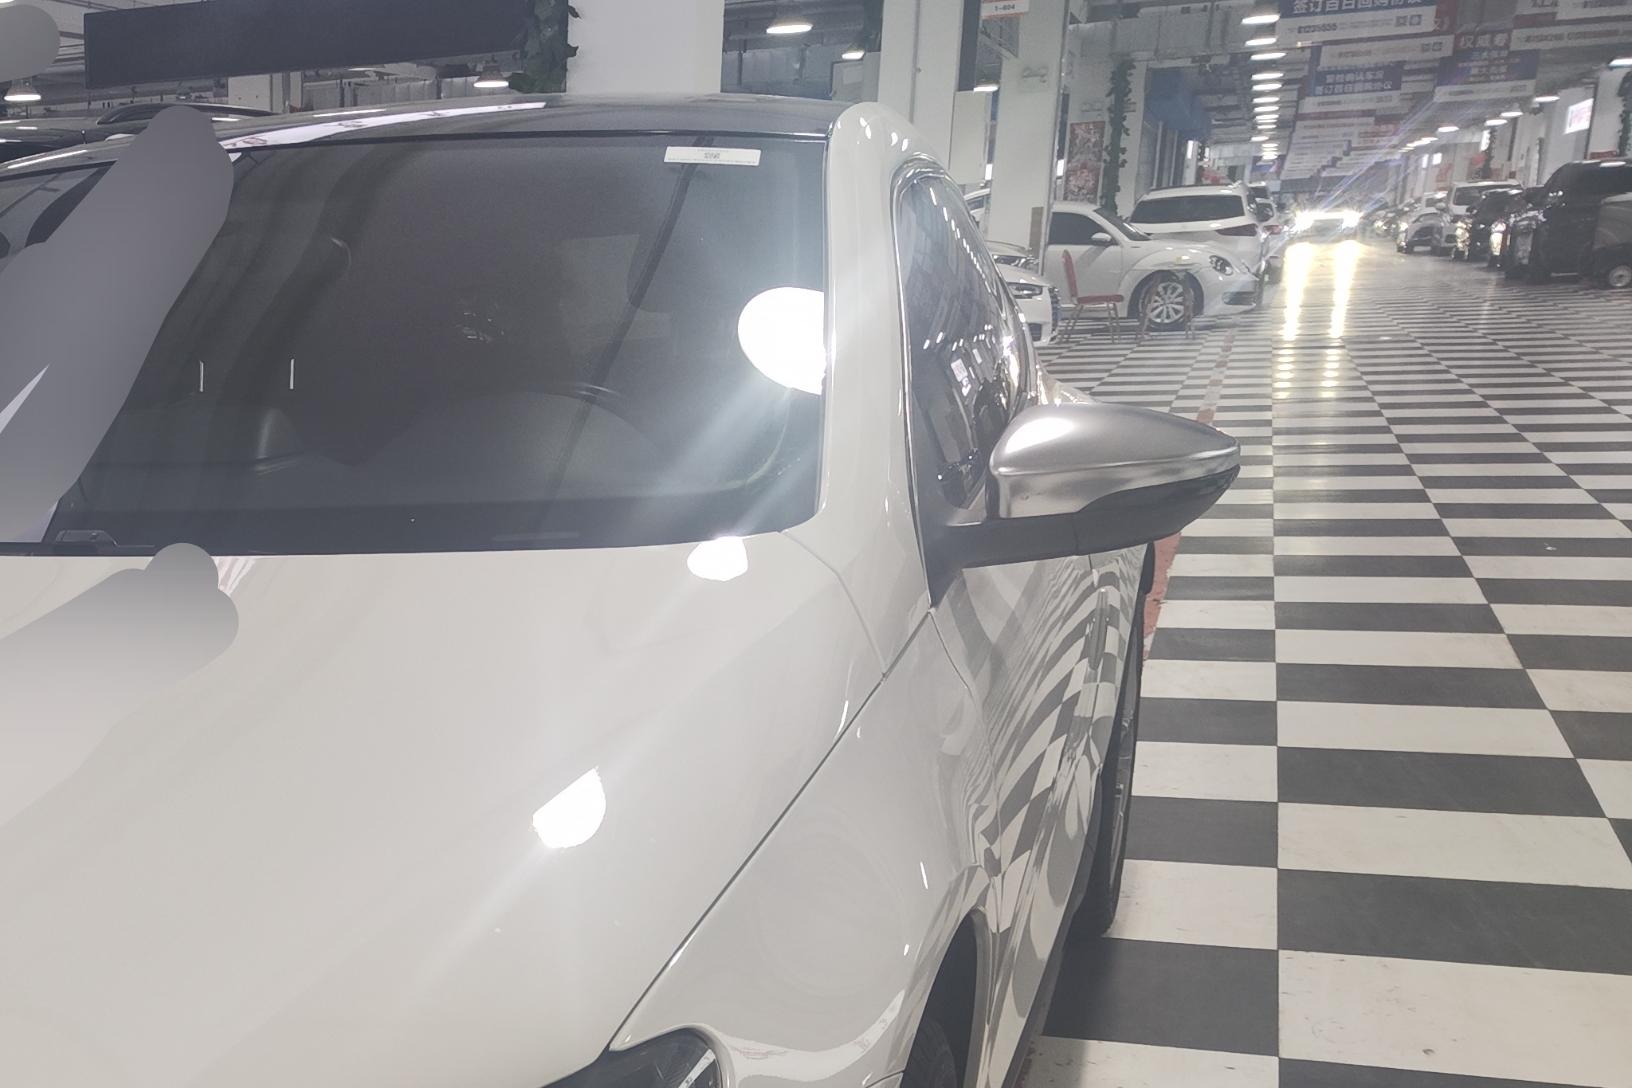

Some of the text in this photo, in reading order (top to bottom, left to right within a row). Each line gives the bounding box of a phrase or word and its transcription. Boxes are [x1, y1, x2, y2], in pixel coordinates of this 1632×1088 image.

[1293, 0, 1421, 14] 签订百日回
